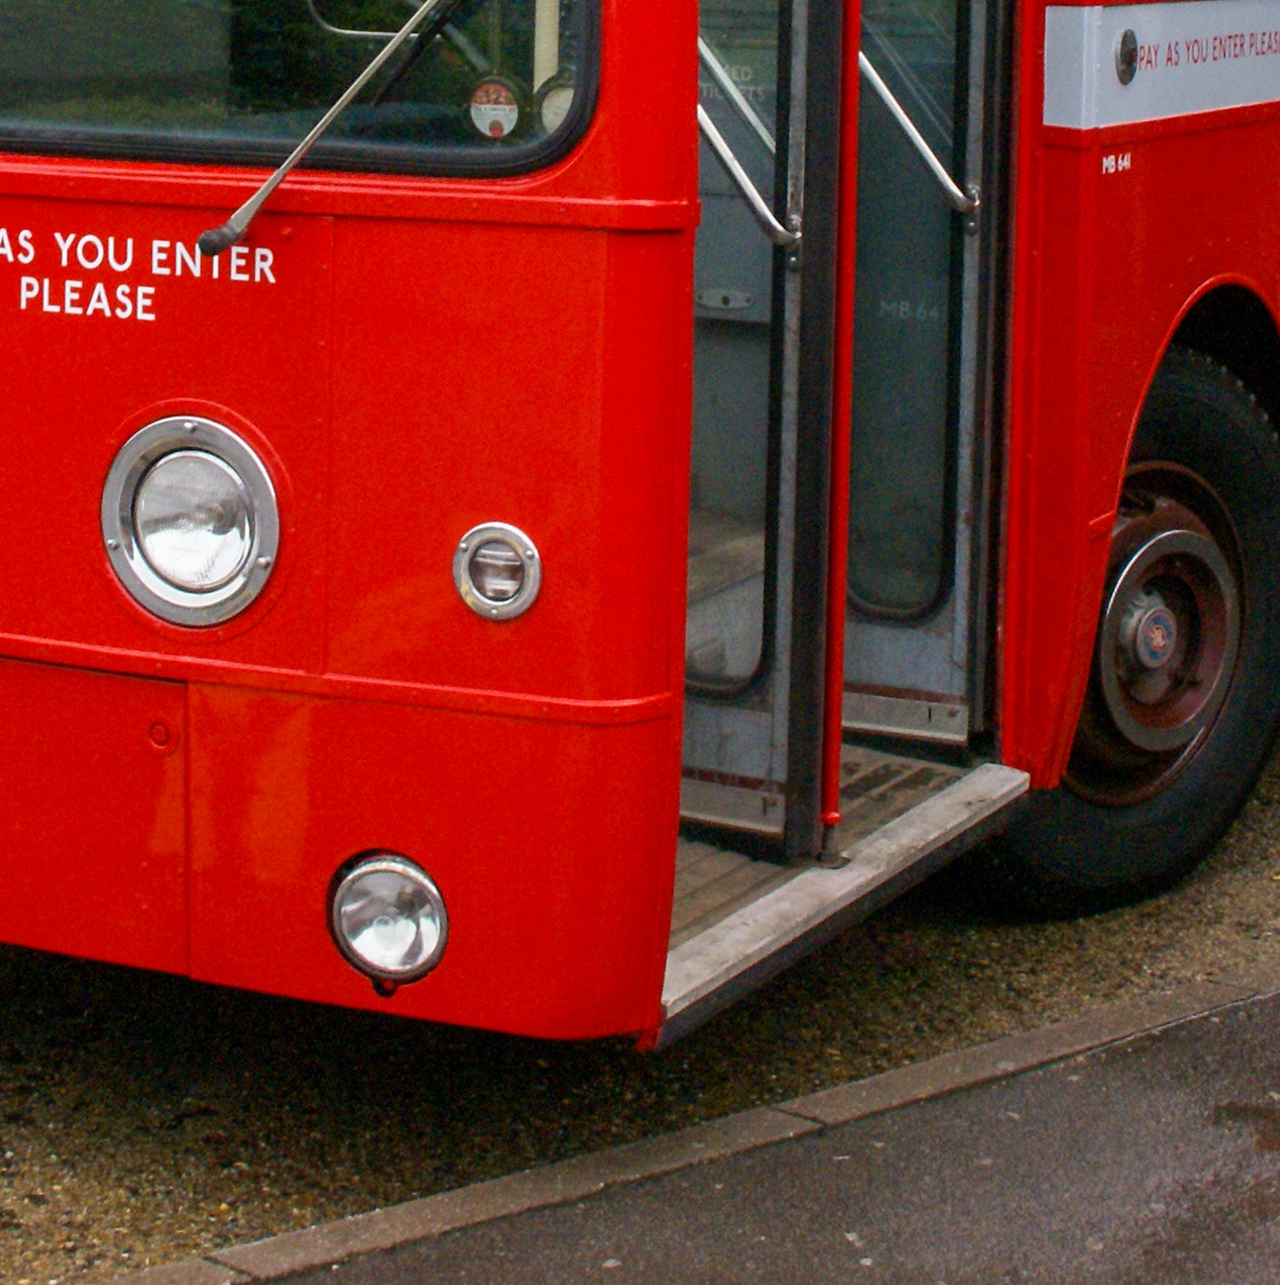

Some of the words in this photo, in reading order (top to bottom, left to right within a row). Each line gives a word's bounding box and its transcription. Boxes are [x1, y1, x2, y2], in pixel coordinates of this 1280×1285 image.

[1138, 44, 1160, 70] PAY
[1165, 41, 1180, 66] AS
[1185, 37, 1209, 64] YOU
[1212, 34, 1246, 61] ENTER
[54, 232, 134, 272] YOU
[19, 275, 157, 321] PLEASE
